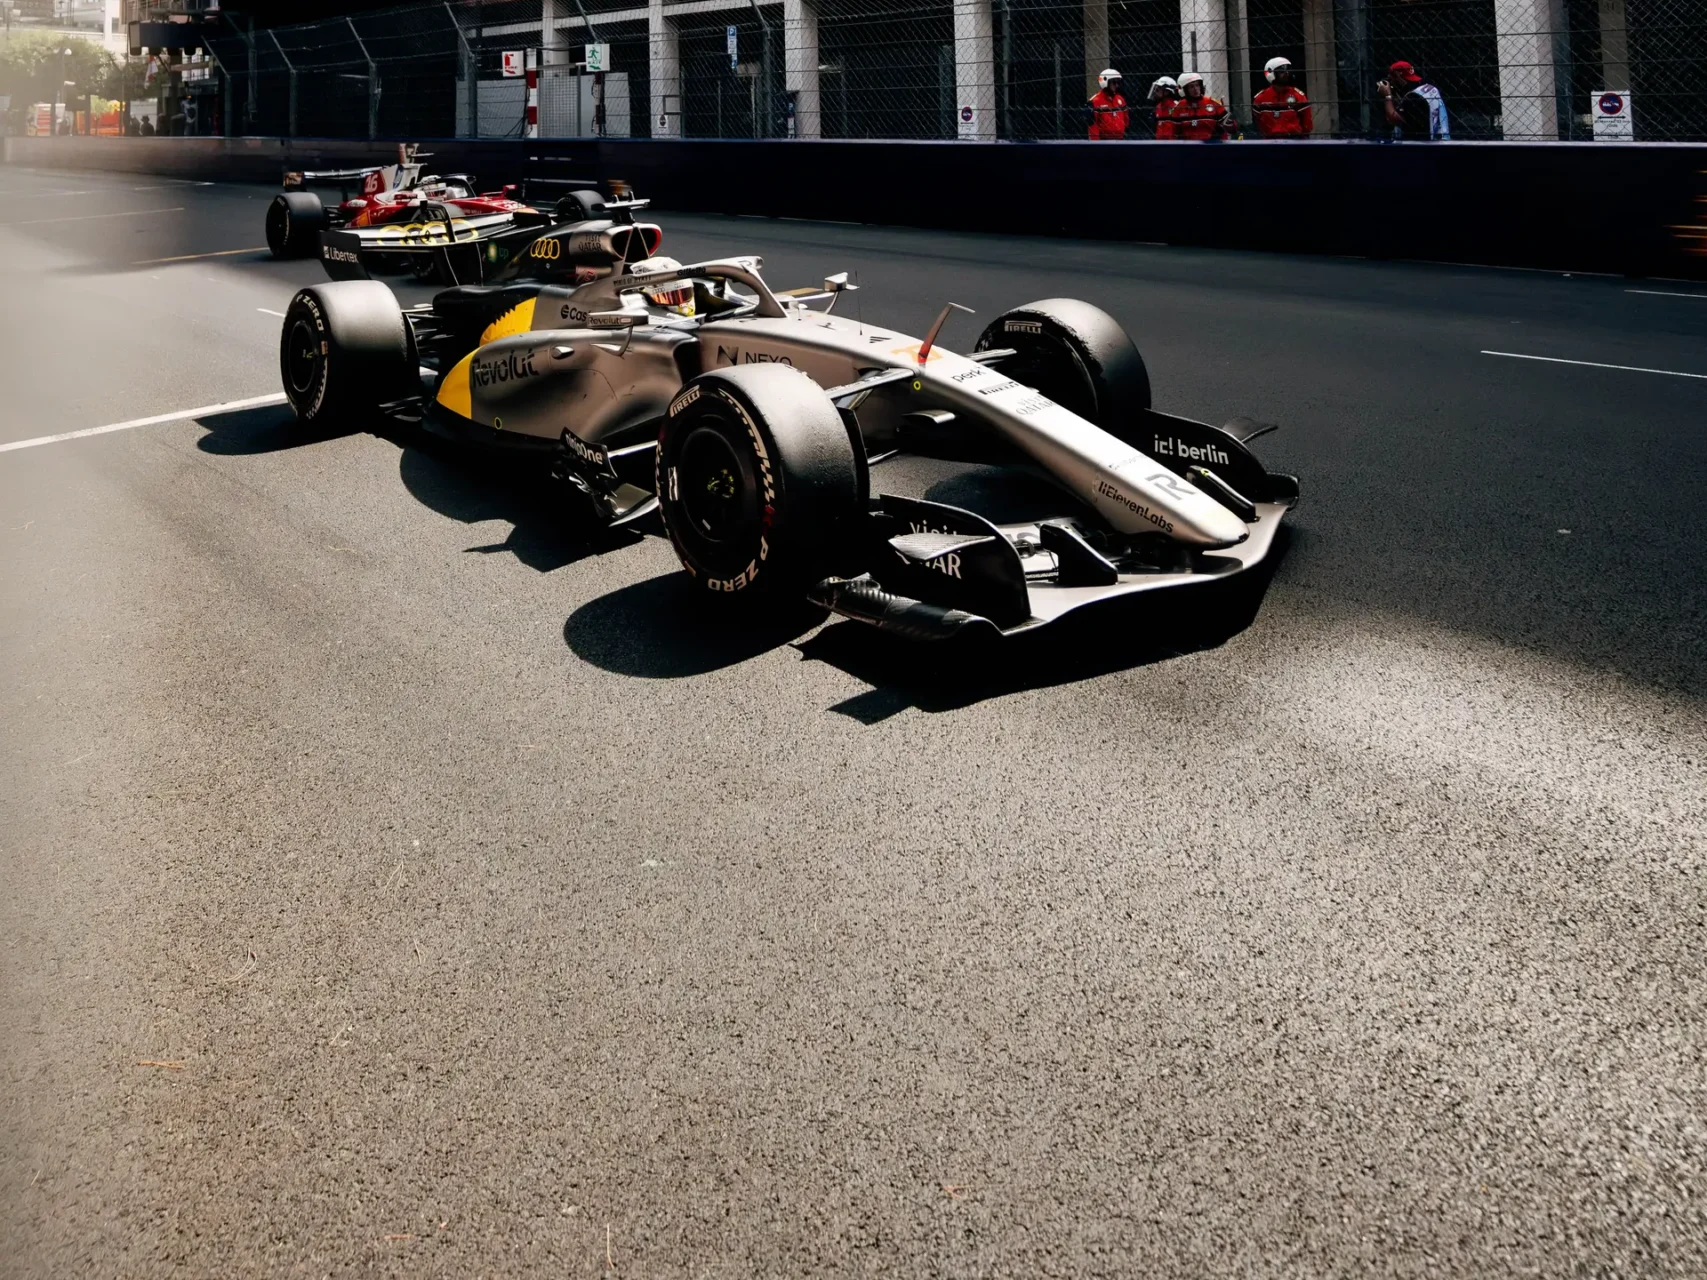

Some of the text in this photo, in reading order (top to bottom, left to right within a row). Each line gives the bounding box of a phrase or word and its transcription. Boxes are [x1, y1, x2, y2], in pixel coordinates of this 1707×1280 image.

[365, 174, 378, 193] 16
[329, 247, 359, 263] Libertex
[303, 295, 324, 331] ZERO
[588, 315, 620, 324] Revolut
[1004, 321, 1042, 334] PIRELLI
[472, 348, 539, 388] Revolut
[669, 384, 700, 418] PIRELLI
[1154, 434, 1229, 465] ic! berlin
[708, 535, 769, 592] P ZERO
